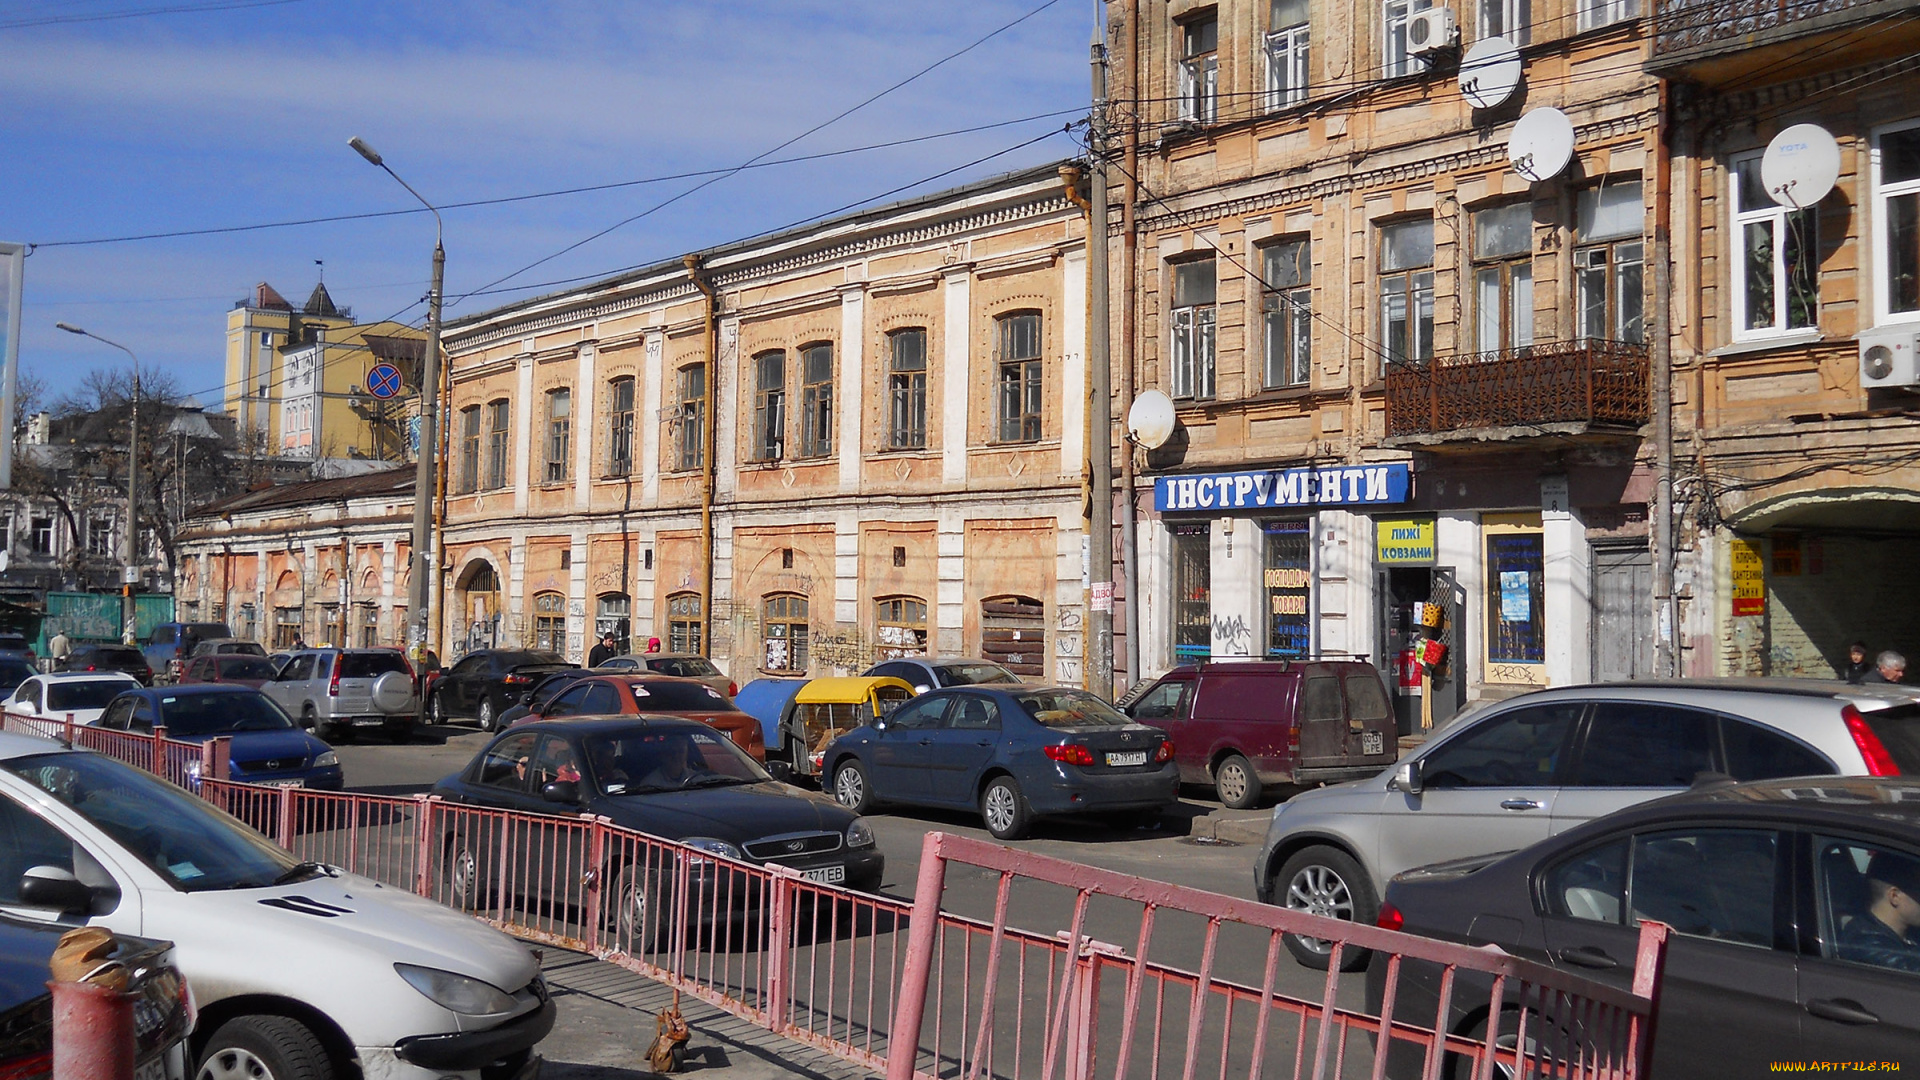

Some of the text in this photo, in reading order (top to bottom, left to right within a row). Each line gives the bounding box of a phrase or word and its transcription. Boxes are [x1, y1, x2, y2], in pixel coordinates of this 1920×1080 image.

[1166, 467, 1389, 509] ІНСТРУМЕНТИ
[1391, 524, 1420, 540] ЛИЖІ
[1382, 547, 1431, 559] КОВЗАНИ
[1272, 595, 1306, 614] ТОВАРИ
